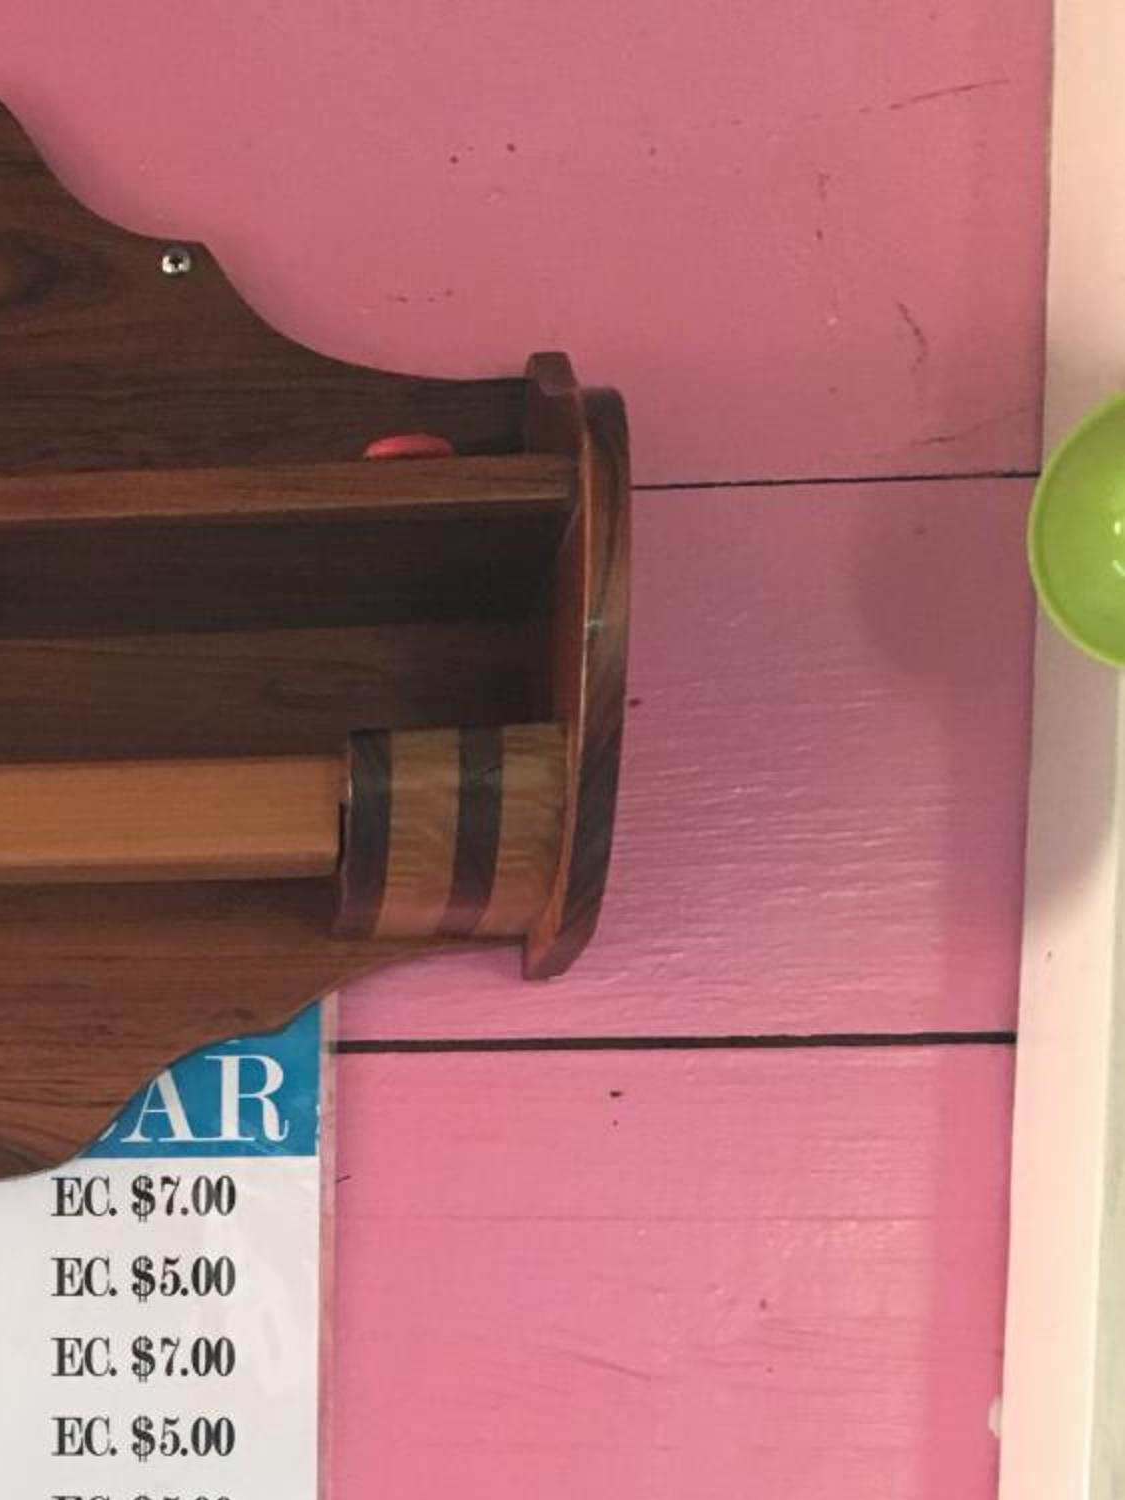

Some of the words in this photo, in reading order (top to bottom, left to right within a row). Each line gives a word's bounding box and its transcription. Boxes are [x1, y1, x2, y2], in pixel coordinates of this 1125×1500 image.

[99, 1054, 290, 1143] AR
[51, 1176, 117, 1218] EC.
[131, 1175, 237, 1222] $7.00
[51, 1257, 117, 1298] EC.
[131, 1256, 237, 1303] $5.00
[51, 1337, 117, 1378] EC.
[131, 1336, 237, 1383] $7.00
[51, 1417, 117, 1458] EC.
[131, 1416, 237, 1463] $5.00
